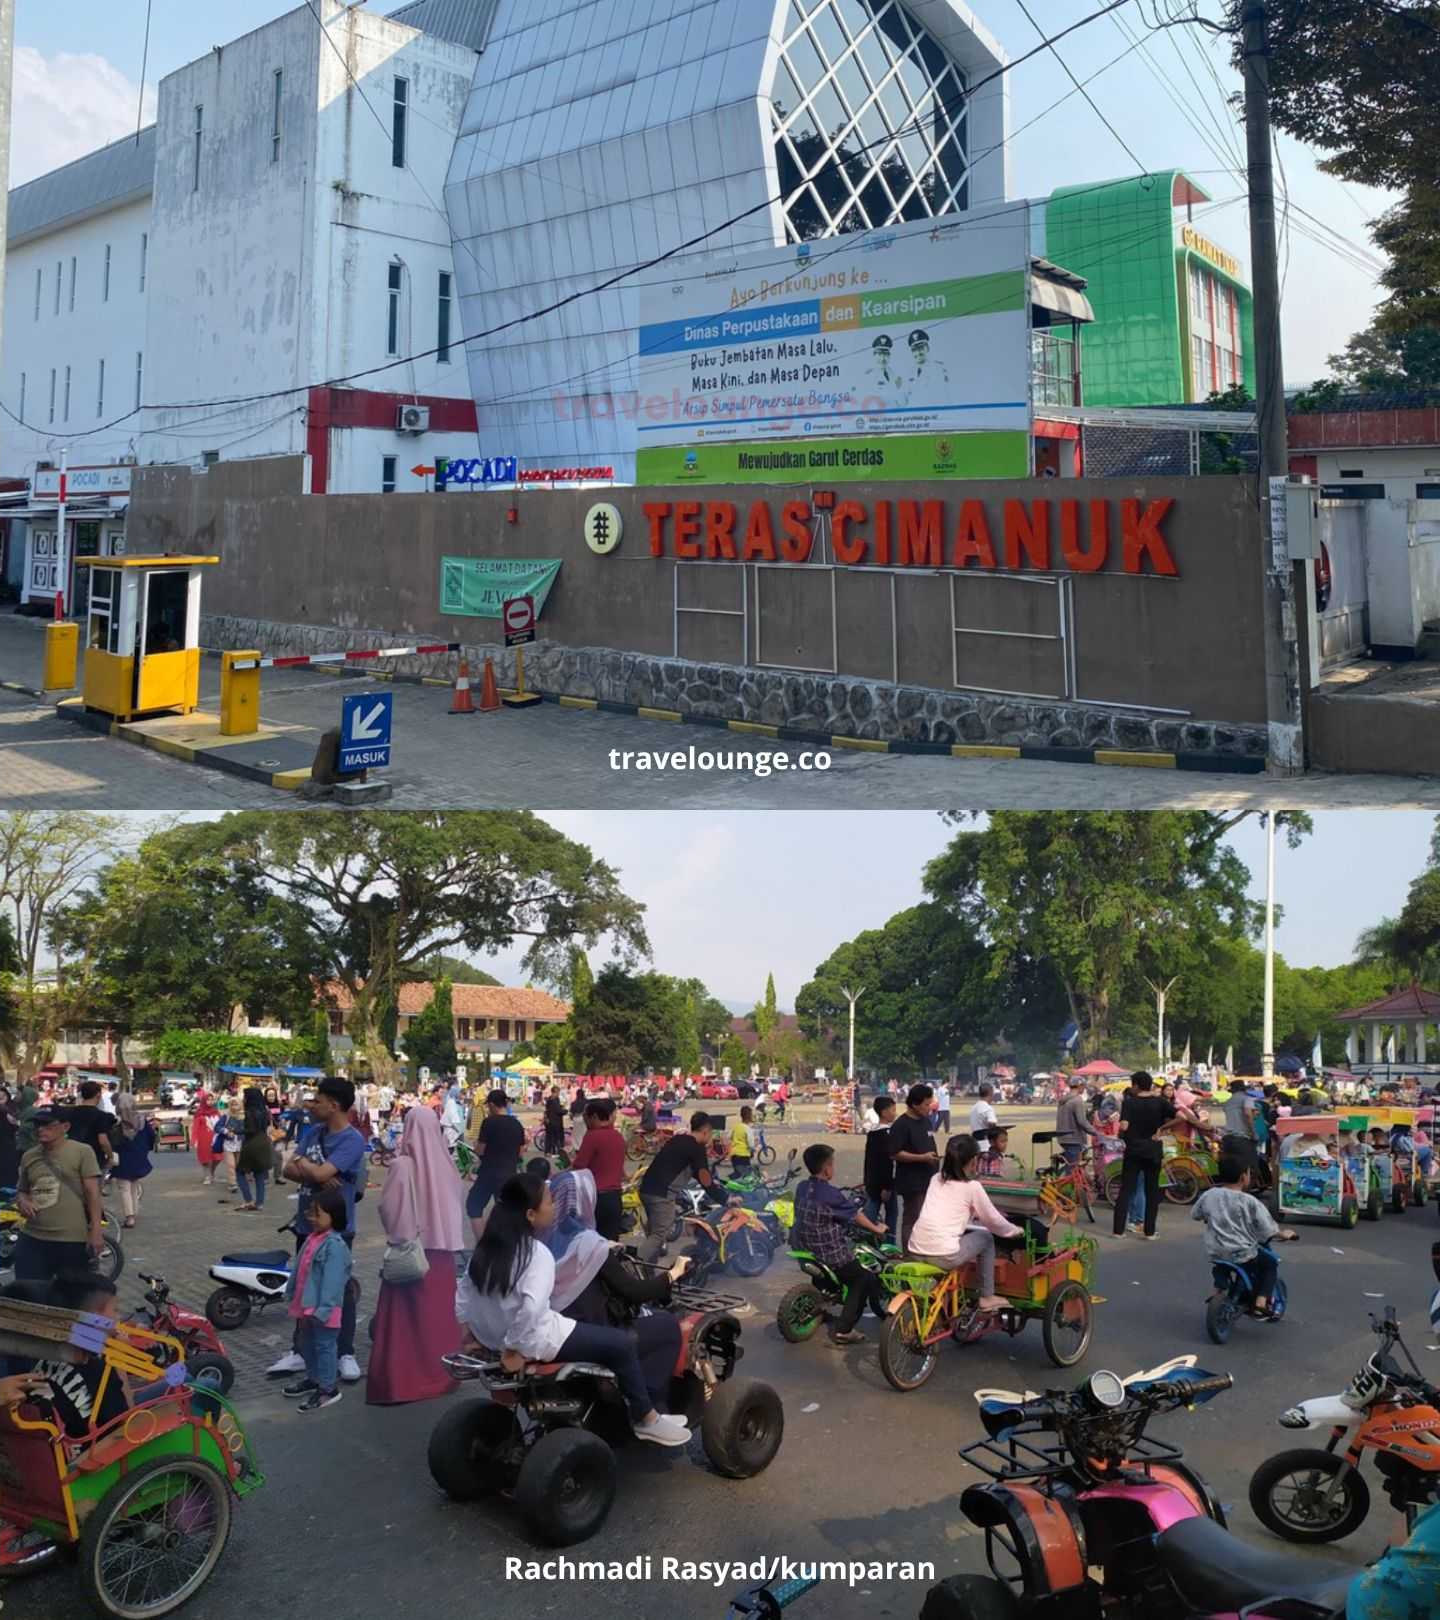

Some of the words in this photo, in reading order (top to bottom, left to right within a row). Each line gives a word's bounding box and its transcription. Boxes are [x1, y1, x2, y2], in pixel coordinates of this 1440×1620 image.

[729, 287, 758, 308] Ayo
[760, 270, 846, 301] Berkunjung
[850, 266, 871, 286] ke
[684, 326, 720, 342] Dinas
[722, 311, 818, 337] Perpustakaan
[825, 305, 854, 322] dan
[861, 294, 947, 319] Kearsipan
[690, 353, 717, 371] Buku
[720, 346, 774, 367] Jembatan
[777, 343, 807, 360] Masa
[692, 374, 718, 392] Masa
[747, 371, 768, 386] dan
[770, 367, 799, 385] Masa
[803, 364, 840, 383] Depan
[738, 451, 806, 471] Mewujudkan
[808, 448, 840, 467] Garut
[842, 448, 884, 467] Cerdas
[642, 499, 813, 564] TERAS
[832, 497, 1180, 577] CIMANUK
[344, 750, 387, 766] MASUK
